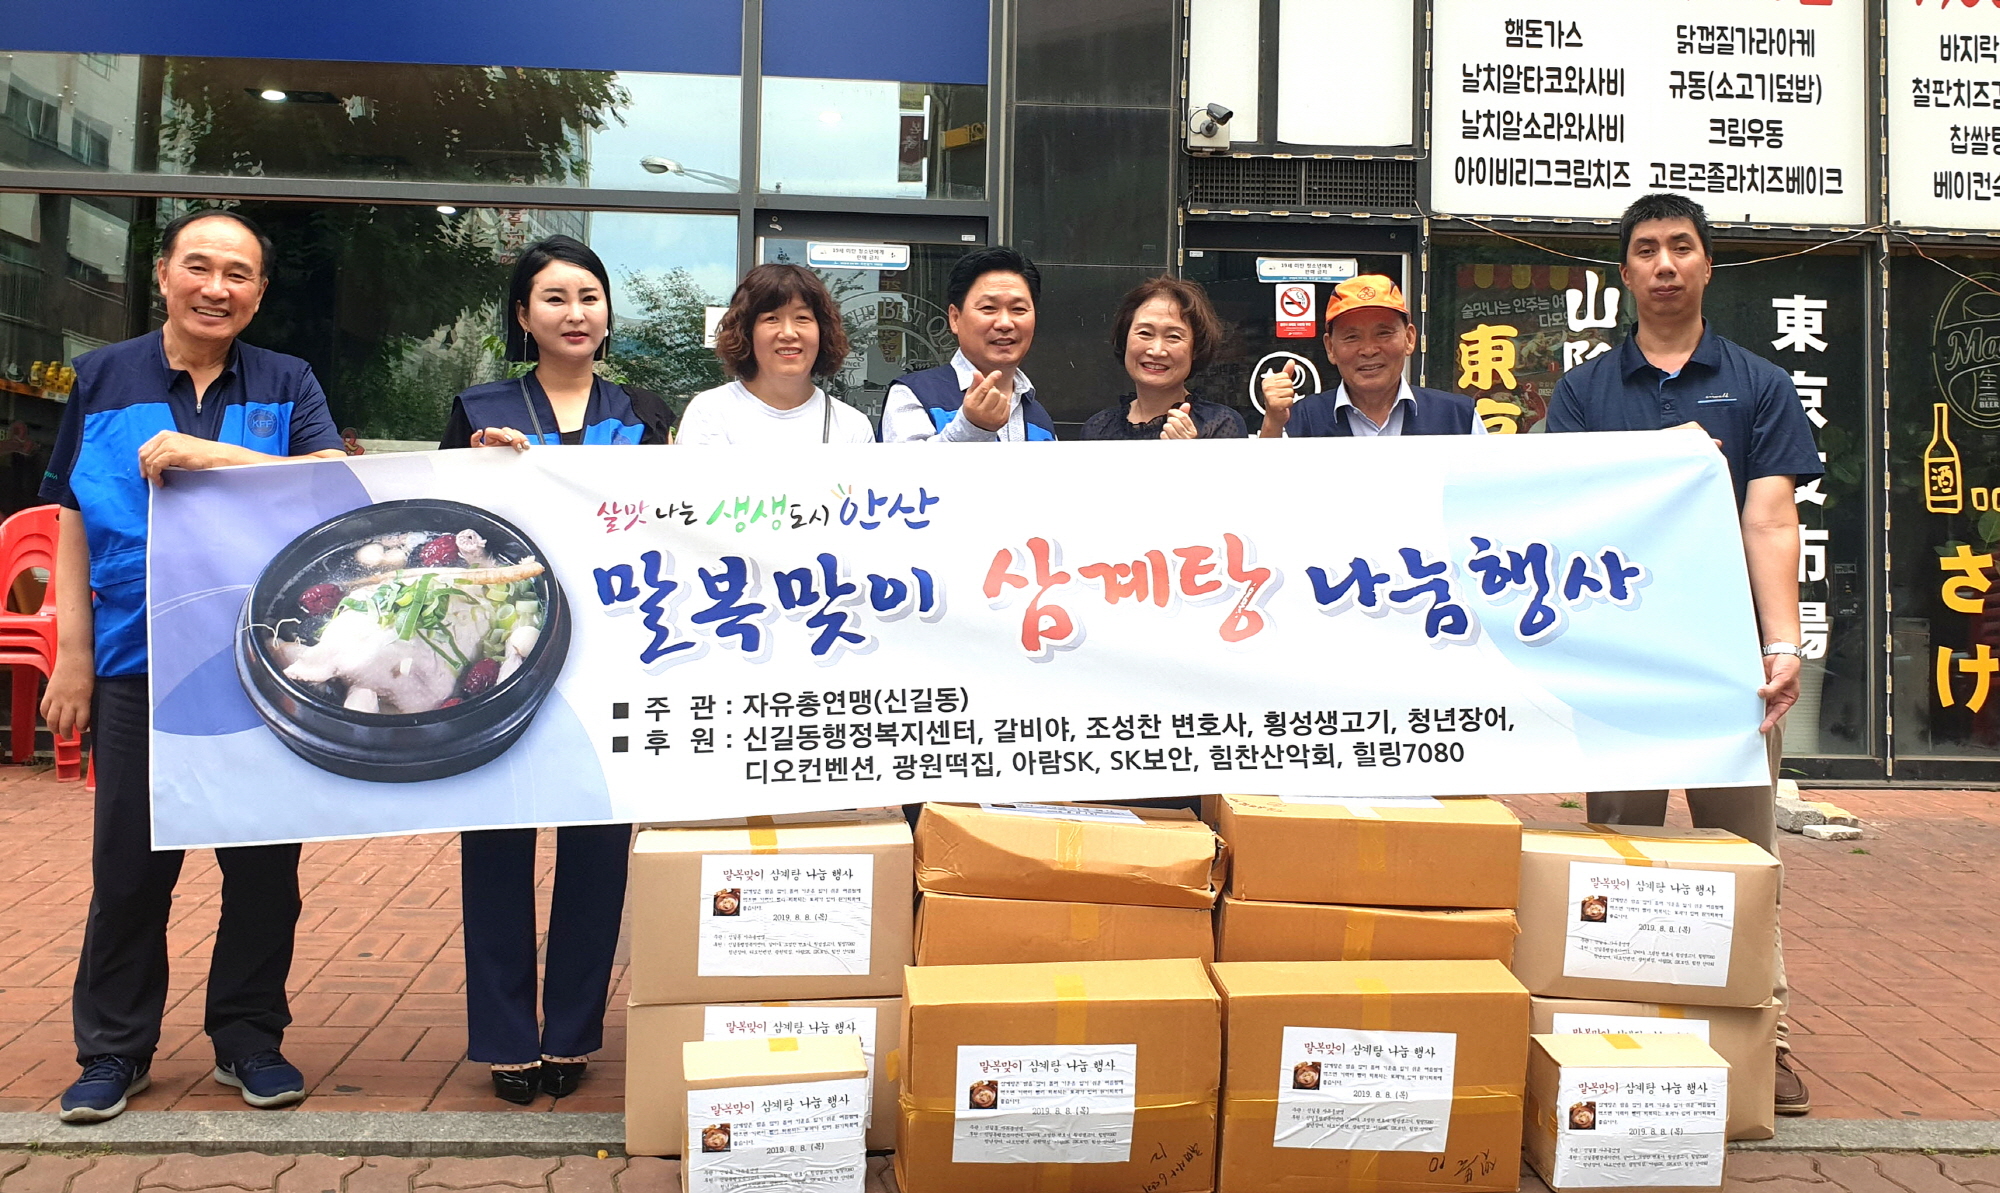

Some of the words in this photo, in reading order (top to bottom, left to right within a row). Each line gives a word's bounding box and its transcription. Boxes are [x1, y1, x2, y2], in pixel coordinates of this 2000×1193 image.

[1504, 18, 1584, 49] 햄돈가스
[1676, 25, 1815, 57] 닭껍질가라아케
[1940, 34, 2000, 63] 바지락
[1462, 63, 1625, 97] 날치알타코와사비
[1668, 71, 1822, 105] 규동(소고기덮밥)
[1462, 109, 1624, 143] 날치알소라와사비
[1708, 118, 1784, 148] 크림우동
[1454, 156, 1632, 189] 아이비리그크림치즈
[1649, 162, 1844, 196] 고르곤졸라치즈베이크
[844, 305, 877, 325] THE
[880, 296, 926, 327] BEST
[1461, 299, 1511, 320] 술맛나는
[1512, 296, 1550, 313] 안주는
[1979, 401, 2000, 409] BEER
[839, 487, 940, 530] 안산
[593, 550, 936, 666] 말복맞이
[981, 535, 1273, 653] 삼계탕
[1936, 544, 1999, 714] さけ
[743, 687, 969, 719] 자유총연맹(신길동)
[743, 719, 984, 752] 신길동행정복지센터,
[993, 716, 1076, 744] 갈비야,
[1086, 714, 1162, 741] 조성찬
[1172, 712, 1253, 739] 변호사,
[1263, 709, 1397, 738] 횡성생고기,
[1407, 706, 1515, 734] 청년장어,
[746, 755, 882, 785] 디오컨벤션,
[893, 751, 1002, 781] 광원떡집,
[1012, 749, 1101, 777] 아람SK,
[1110, 746, 1199, 774] SK보안,
[1208, 742, 1343, 771] 힘찬산악회,
[1352, 741, 1465, 768] 힐링7080
[723, 868, 764, 882] 말복맞이
[770, 868, 801, 881] 삼계탕
[806, 868, 828, 881] 나눔
[832, 868, 853, 881] 행사
[1590, 876, 1630, 890] 말복맞이
[1636, 880, 1666, 893] 삼계탕
[1670, 883, 1691, 896] 나눔
[1695, 884, 1716, 897] 행사
[772, 914, 791, 922] 2019.
[1638, 923, 1656, 932] 2019.
[726, 1020, 766, 1034] 말복맞이
[773, 1021, 804, 1034] 삼계탕
[809, 1021, 830, 1034] 나눔
[835, 1021, 856, 1034] 행사
[1304, 1041, 1345, 1055] 말복맞이
[1351, 1044, 1384, 1058] 삼계탕
[1388, 1045, 1410, 1059] 나눔
[1414, 1046, 1436, 1059] 행사
[979, 1060, 1022, 1073] 말복맞이
[1029, 1059, 1061, 1072] 삼계탕
[1066, 1059, 1089, 1072] 나눔
[1094, 1059, 1116, 1072] 행사
[1353, 1090, 1371, 1099] 2019.
[1578, 1081, 1619, 1095] 말복맞이
[1625, 1082, 1656, 1095] 삼계탕
[1661, 1082, 1682, 1095] 나눔
[1686, 1082, 1708, 1095] 행사
[711, 1100, 754, 1116] 말복맞이
[761, 1098, 794, 1113] 삼계탕
[800, 1096, 823, 1110] 나눔
[828, 1094, 850, 1108] 행사
[1032, 1107, 1051, 1116] 2019.
[1628, 1128, 1648, 1136] 2019.
[766, 1146, 786, 1155] 2019.
